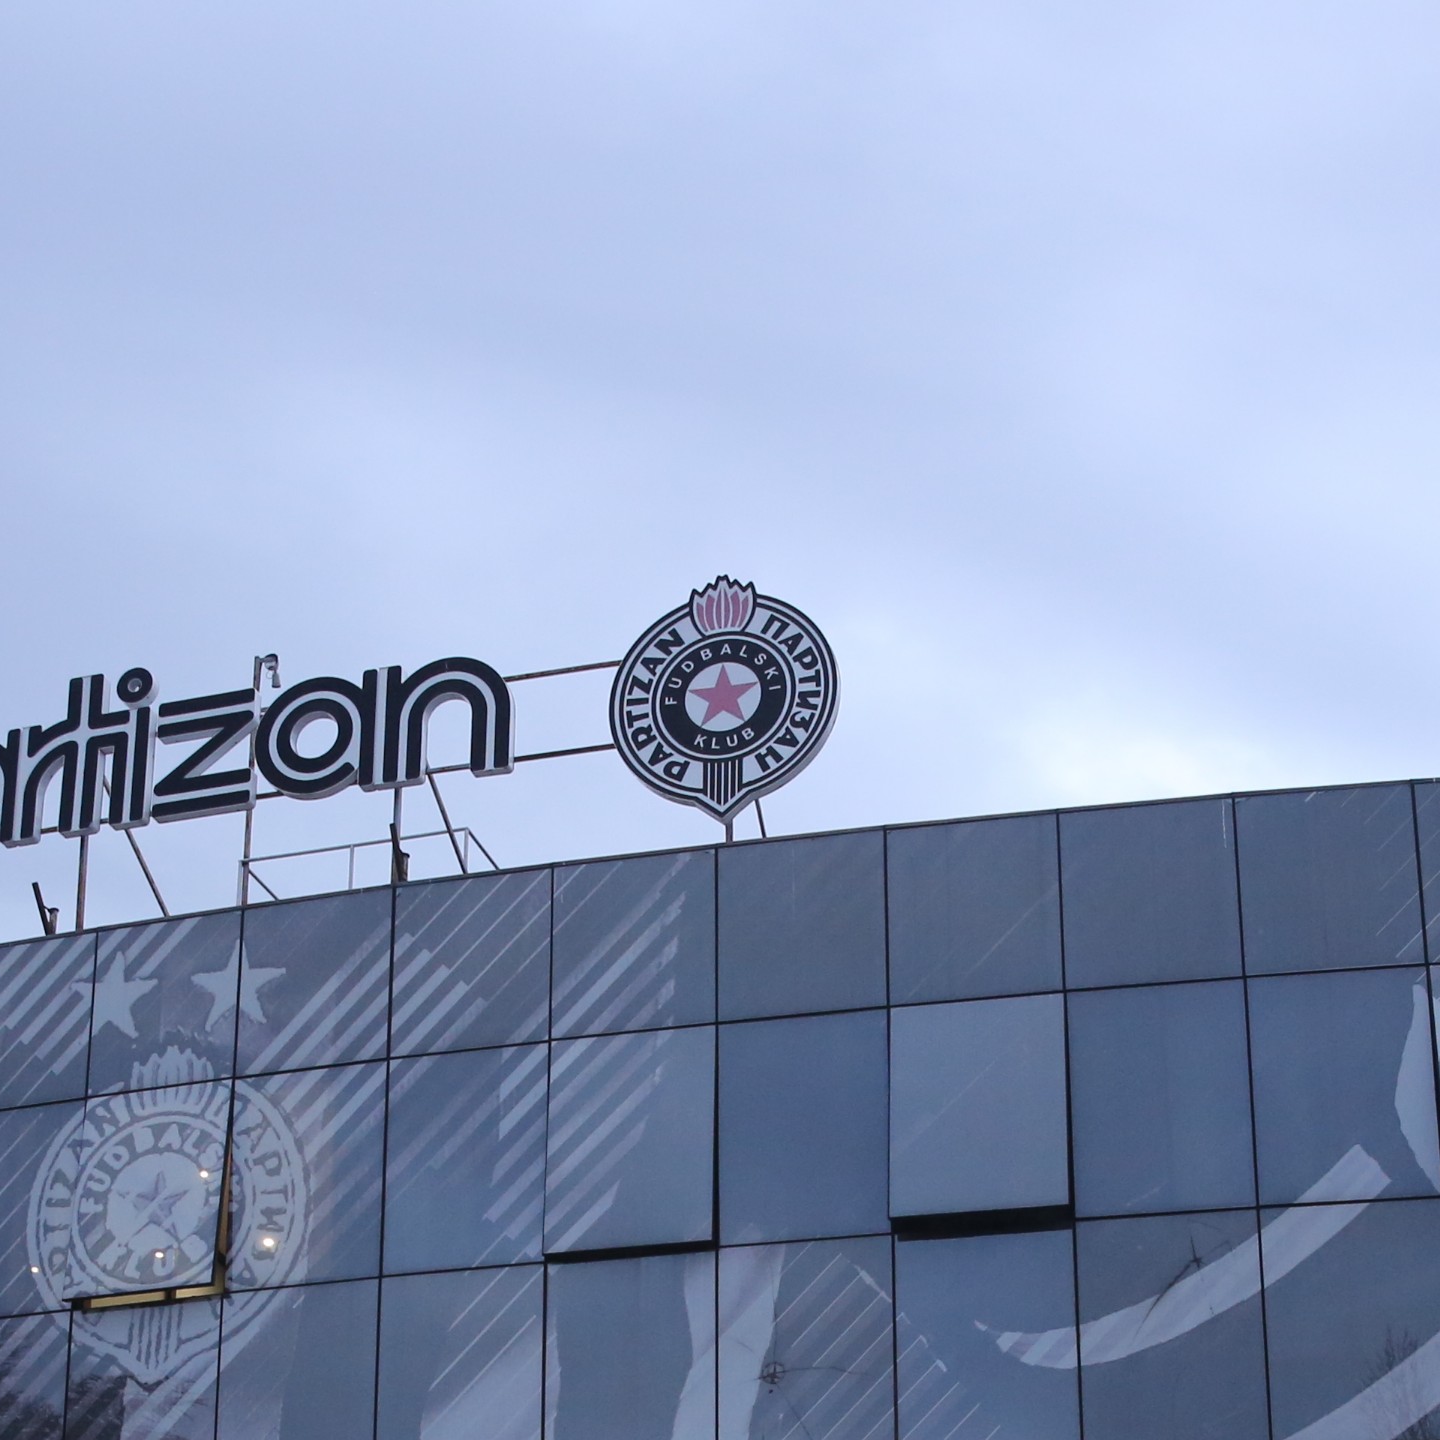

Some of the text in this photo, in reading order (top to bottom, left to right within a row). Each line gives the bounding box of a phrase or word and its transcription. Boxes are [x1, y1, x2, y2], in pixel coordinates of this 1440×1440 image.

[625, 627, 692, 783] PARTIZAN
[664, 642, 782, 706] FUDBALSKI
[754, 613, 823, 774] ПАРТИЗАН
[693, 726, 756, 750] KLUB
